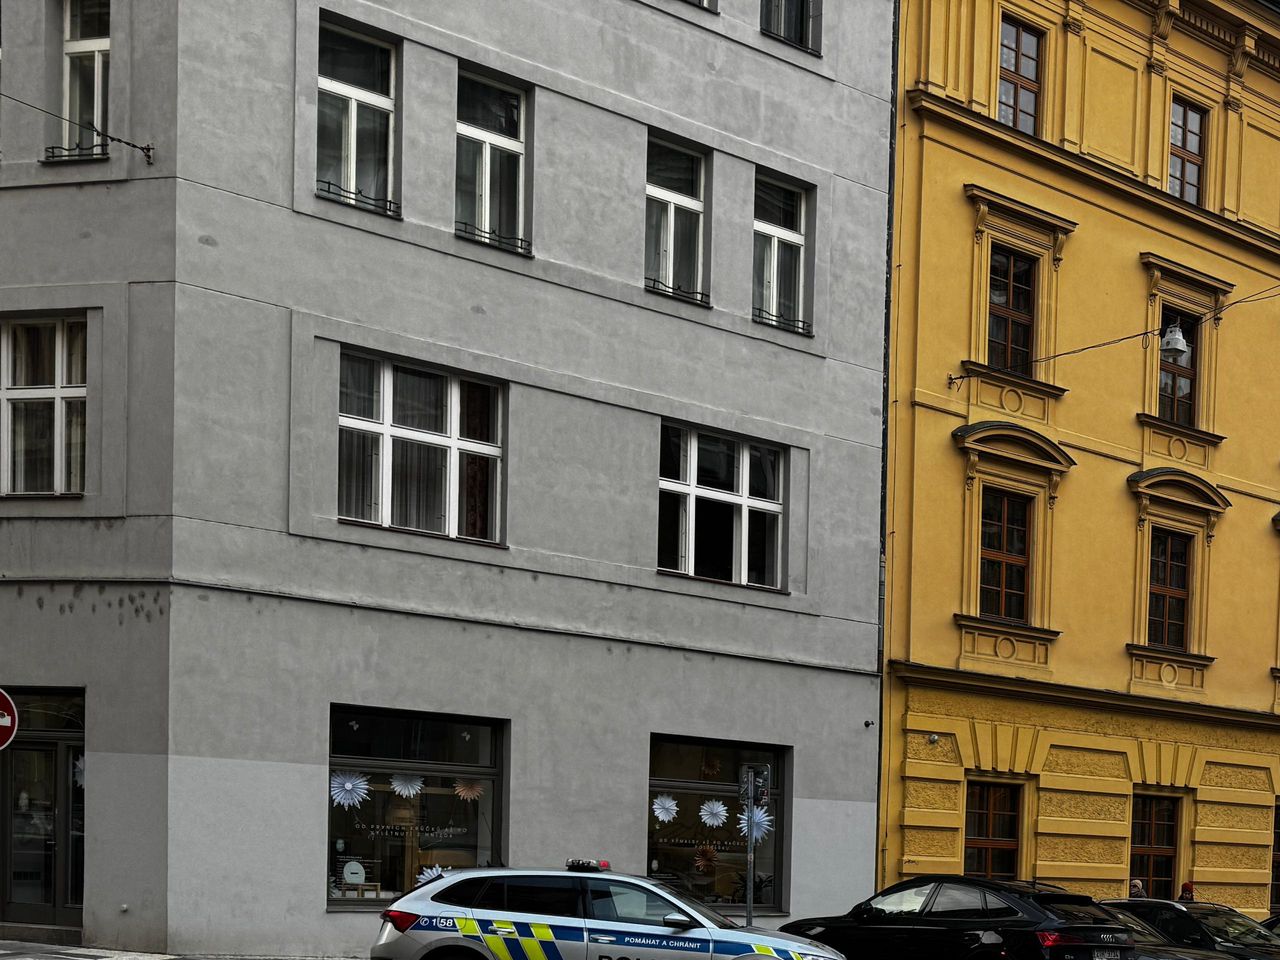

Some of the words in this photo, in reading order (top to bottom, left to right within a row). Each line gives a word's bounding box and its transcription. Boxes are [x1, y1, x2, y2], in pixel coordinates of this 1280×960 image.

[432, 918, 453, 927] 158
[624, 936, 660, 945] POMÁHAT
[668, 940, 701, 949] CHRÁNIT
